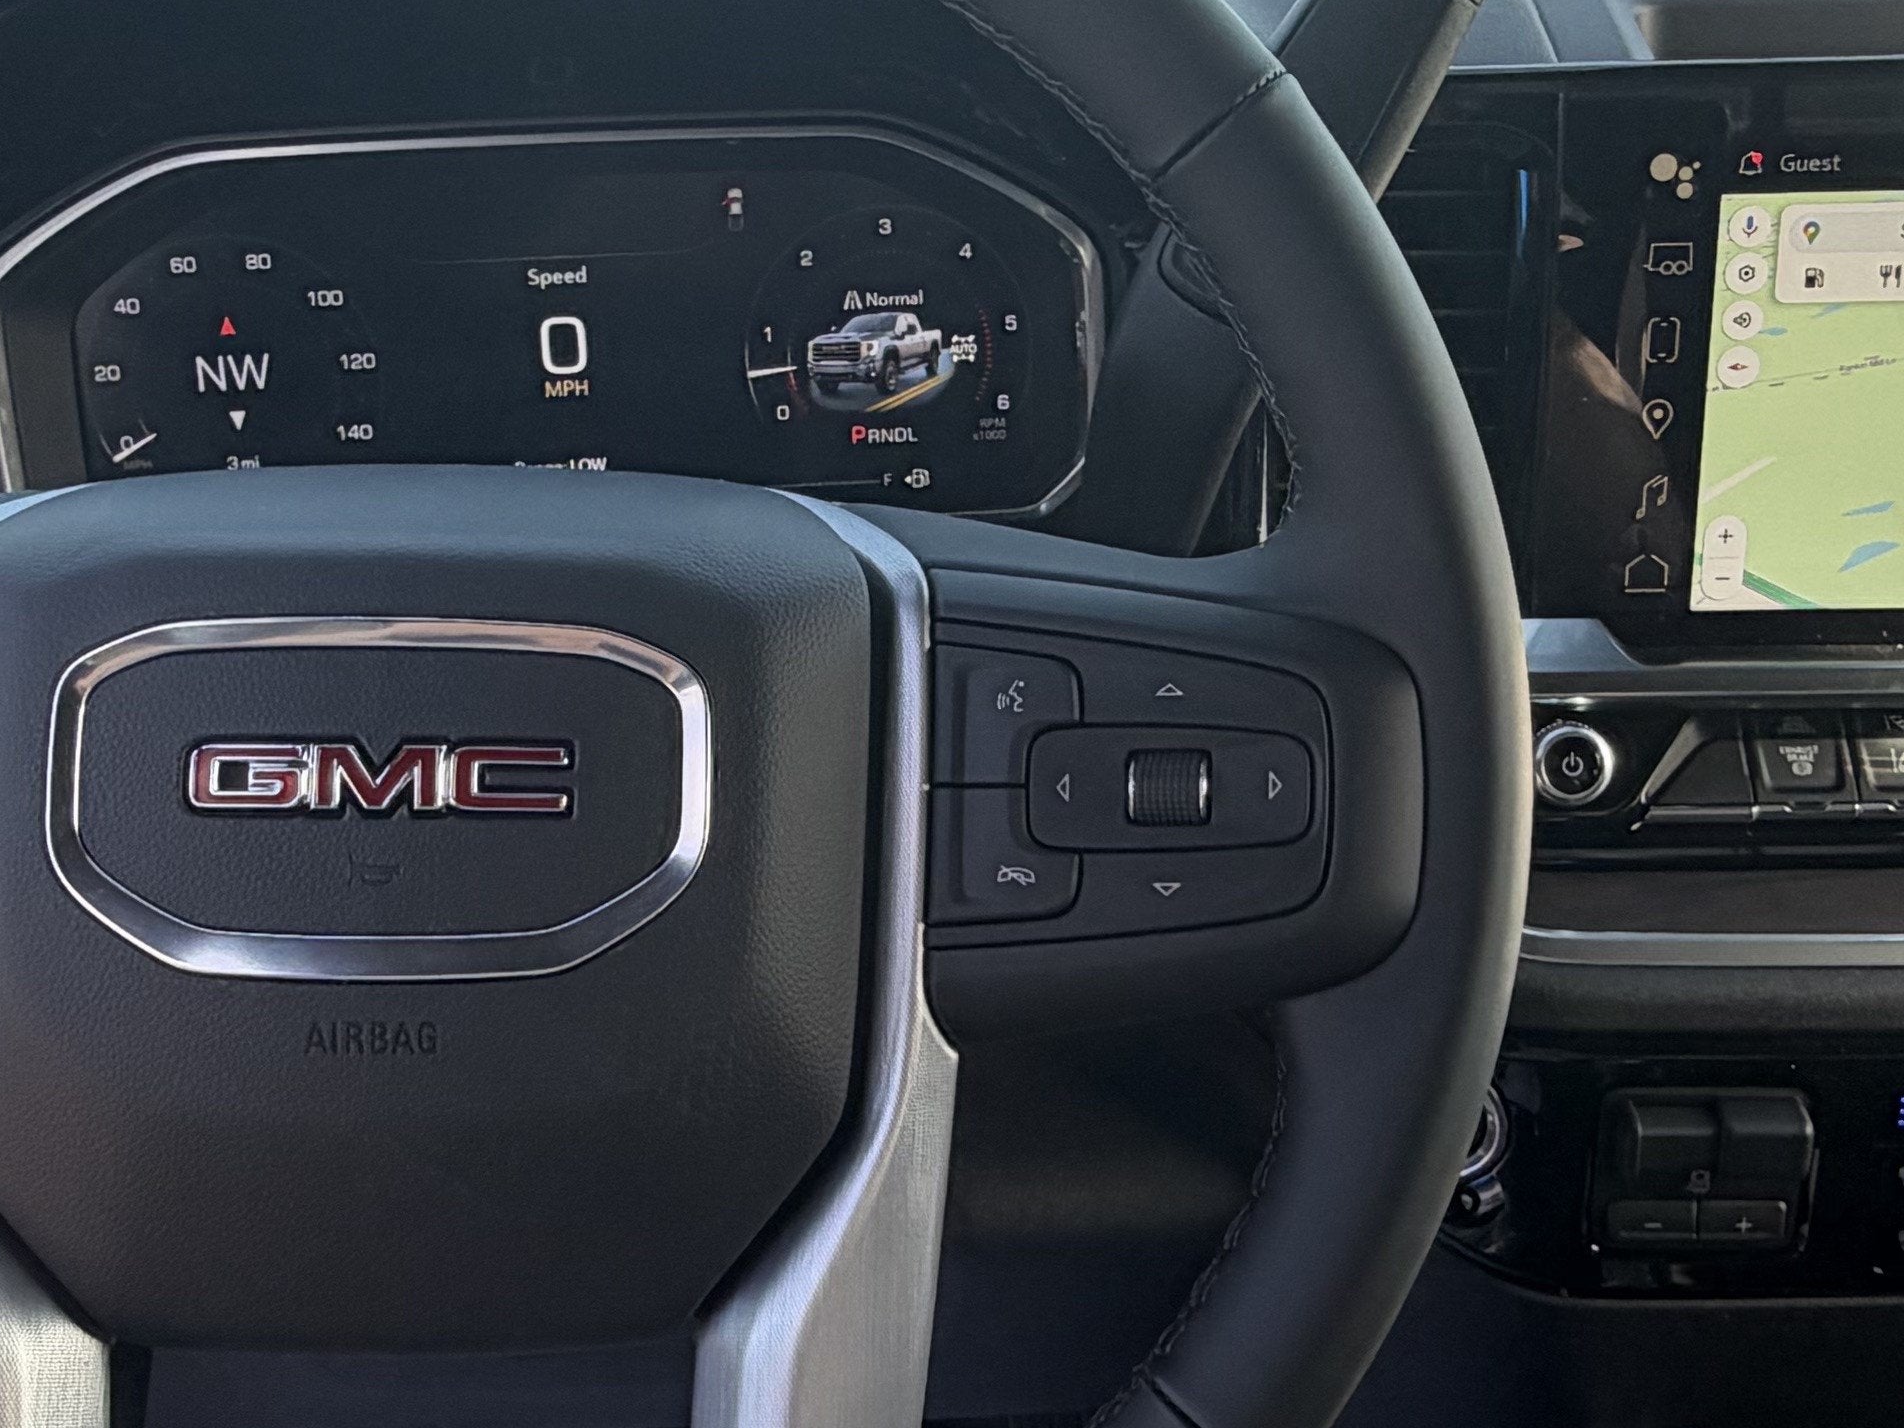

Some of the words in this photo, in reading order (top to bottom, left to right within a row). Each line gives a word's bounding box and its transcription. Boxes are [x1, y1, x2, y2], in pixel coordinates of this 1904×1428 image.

[1779, 153, 1842, 172] Guest
[878, 218, 893, 235] 3
[799, 250, 814, 267] 2
[958, 243, 973, 259] 4
[169, 256, 197, 274] 60
[245, 253, 272, 271] 80
[527, 264, 588, 290] Speed
[113, 297, 141, 315] 40
[307, 289, 344, 307] 100
[865, 289, 925, 308] Normal
[1004, 314, 1018, 331] 5
[763, 326, 773, 343] 1
[539, 315, 588, 375] 0
[950, 343, 978, 355] AUTO
[339, 352, 376, 370] 120
[94, 364, 121, 382] 20
[195, 352, 270, 393] NW
[545, 379, 590, 398] MPH
[997, 393, 1010, 410] 6
[776, 404, 790, 421] 0
[335, 423, 374, 441] 140
[226, 455, 239, 471] 3
[240, 455, 260, 470] mi
[188, 742, 576, 812] GMC
[302, 1019, 438, 1058] AIRBAG
